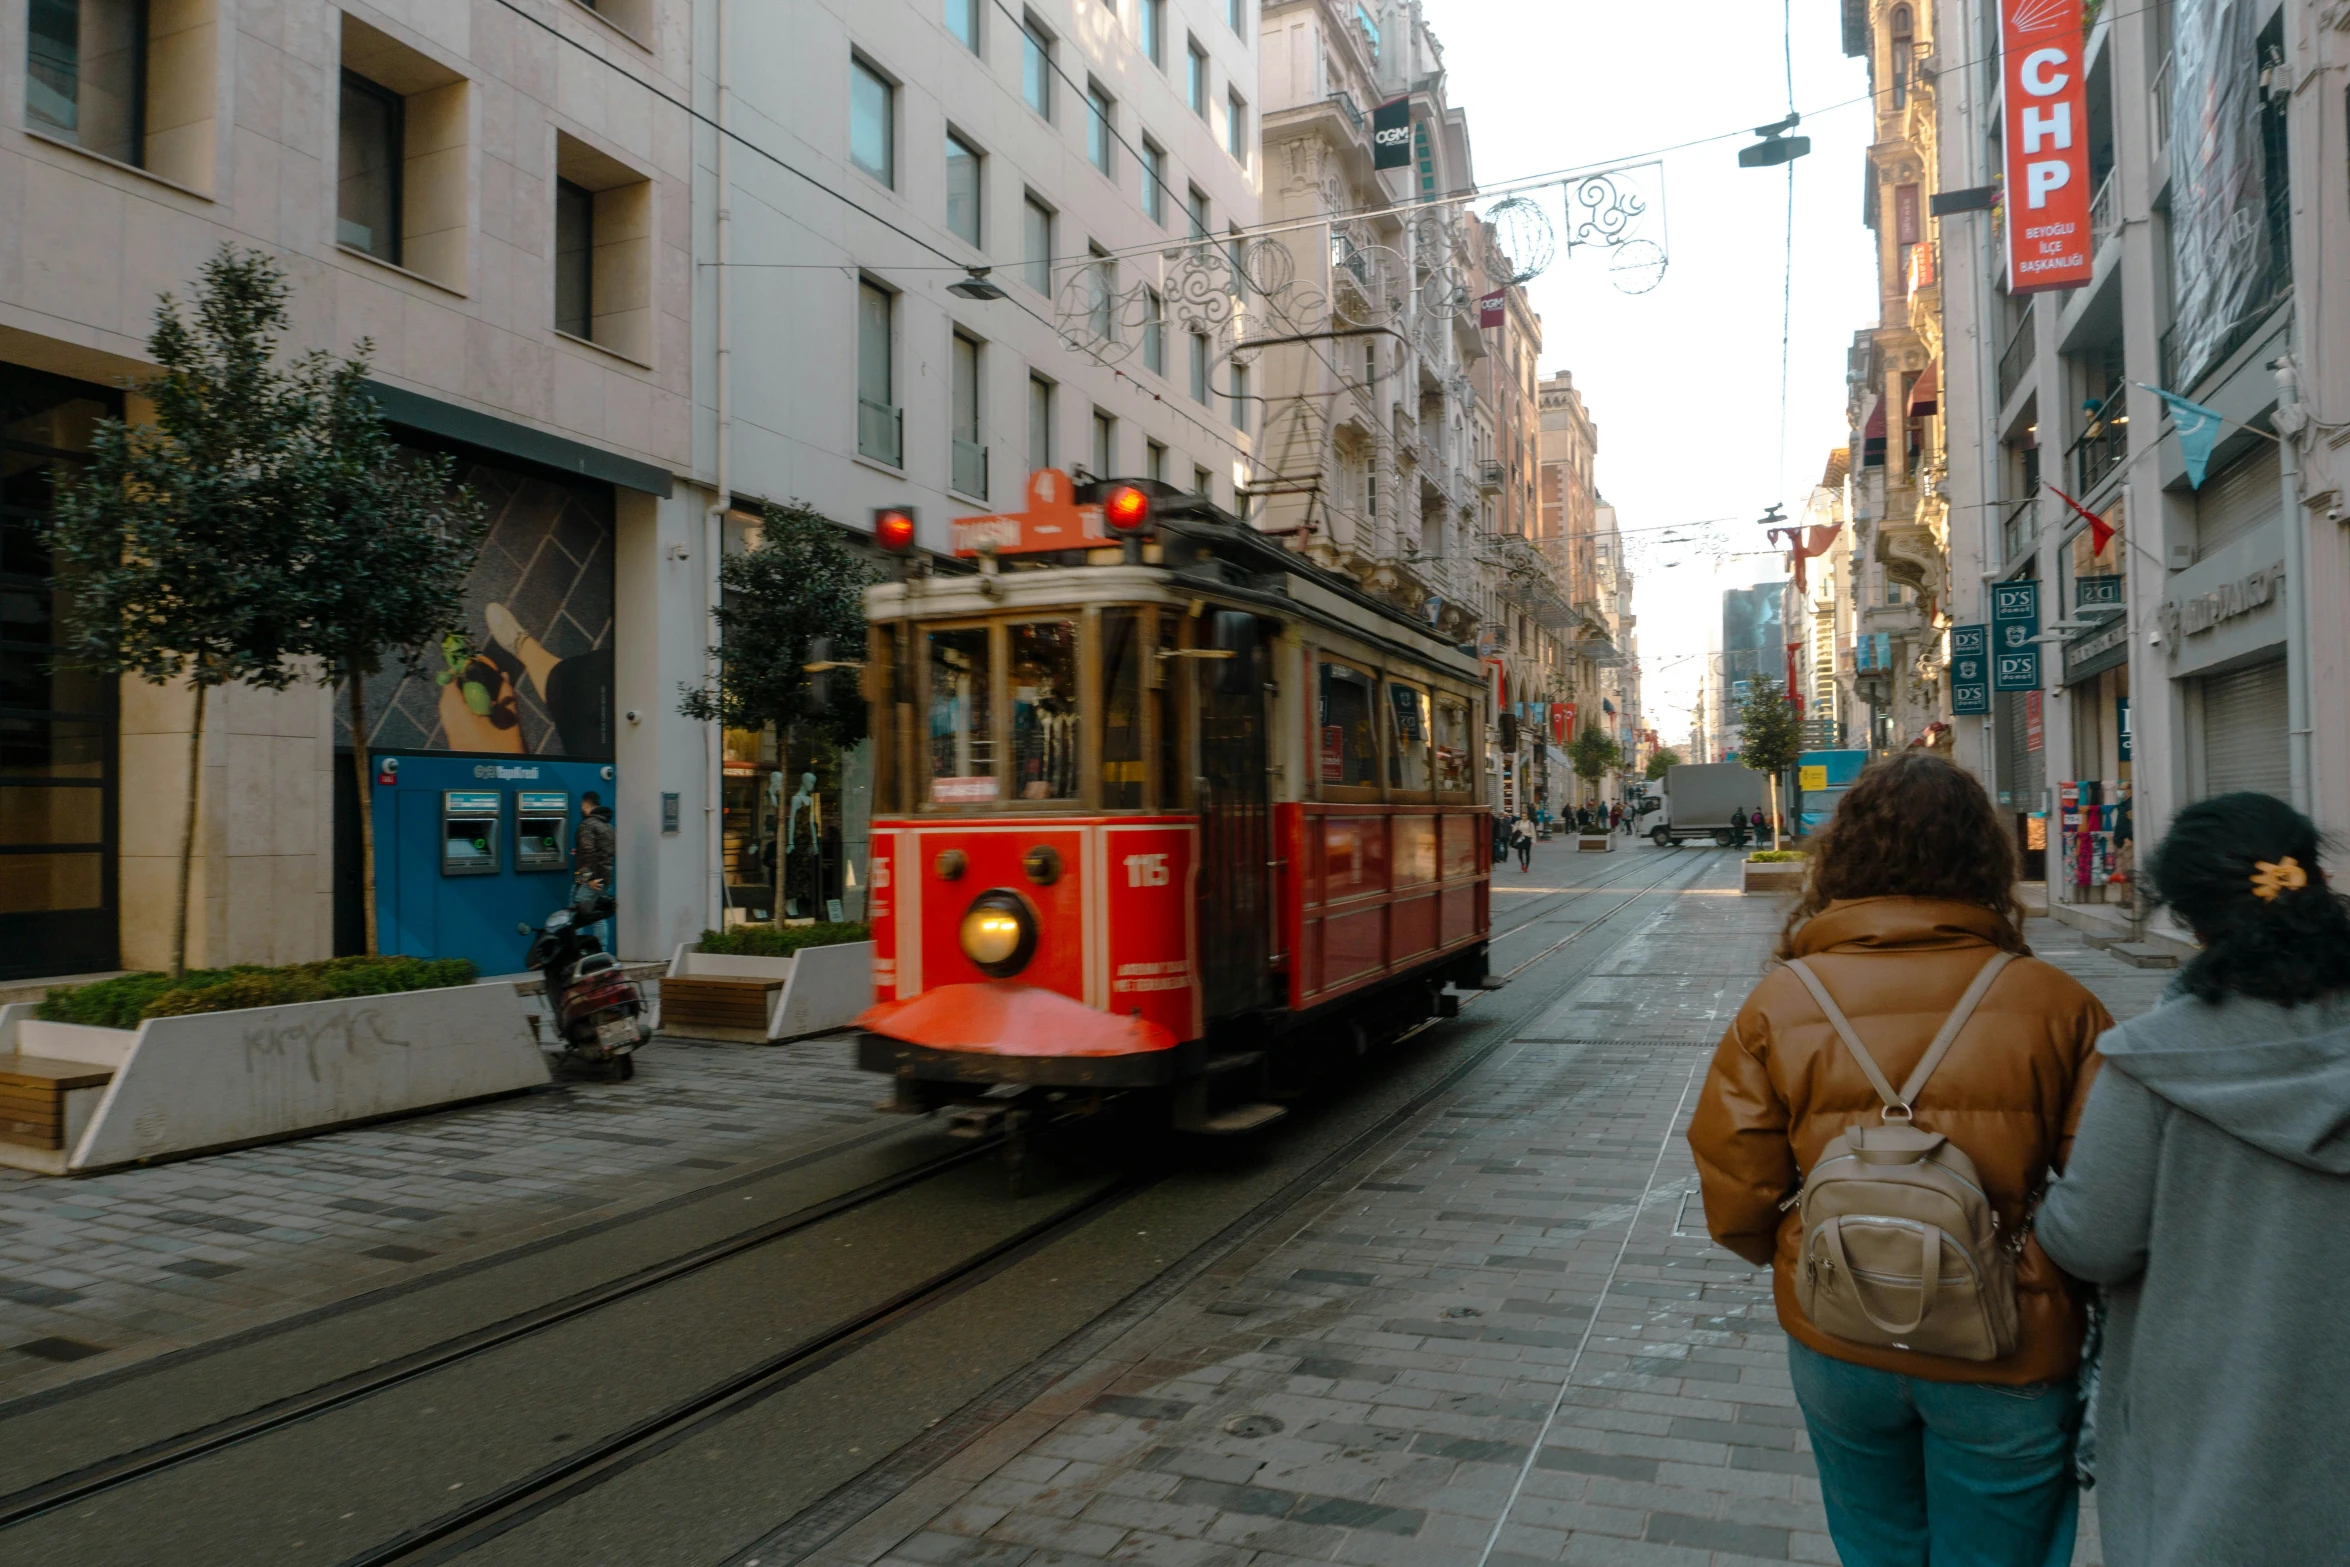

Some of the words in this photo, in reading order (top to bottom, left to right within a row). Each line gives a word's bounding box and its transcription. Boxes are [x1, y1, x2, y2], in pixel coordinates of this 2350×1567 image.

[2020, 48, 2072, 210] CHP
[2026, 222, 2075, 239] BEYOĞLU
[2039, 241, 2062, 255] İLÇE
[2019, 254, 2083, 274] BAŞKANLIĞI
[1999, 591, 2030, 606] D'S
[1955, 633, 1980, 646] D'S
[2001, 658, 2032, 673] D'S
[1957, 687, 1982, 700] D'S
[1122, 853, 1169, 888] 115
